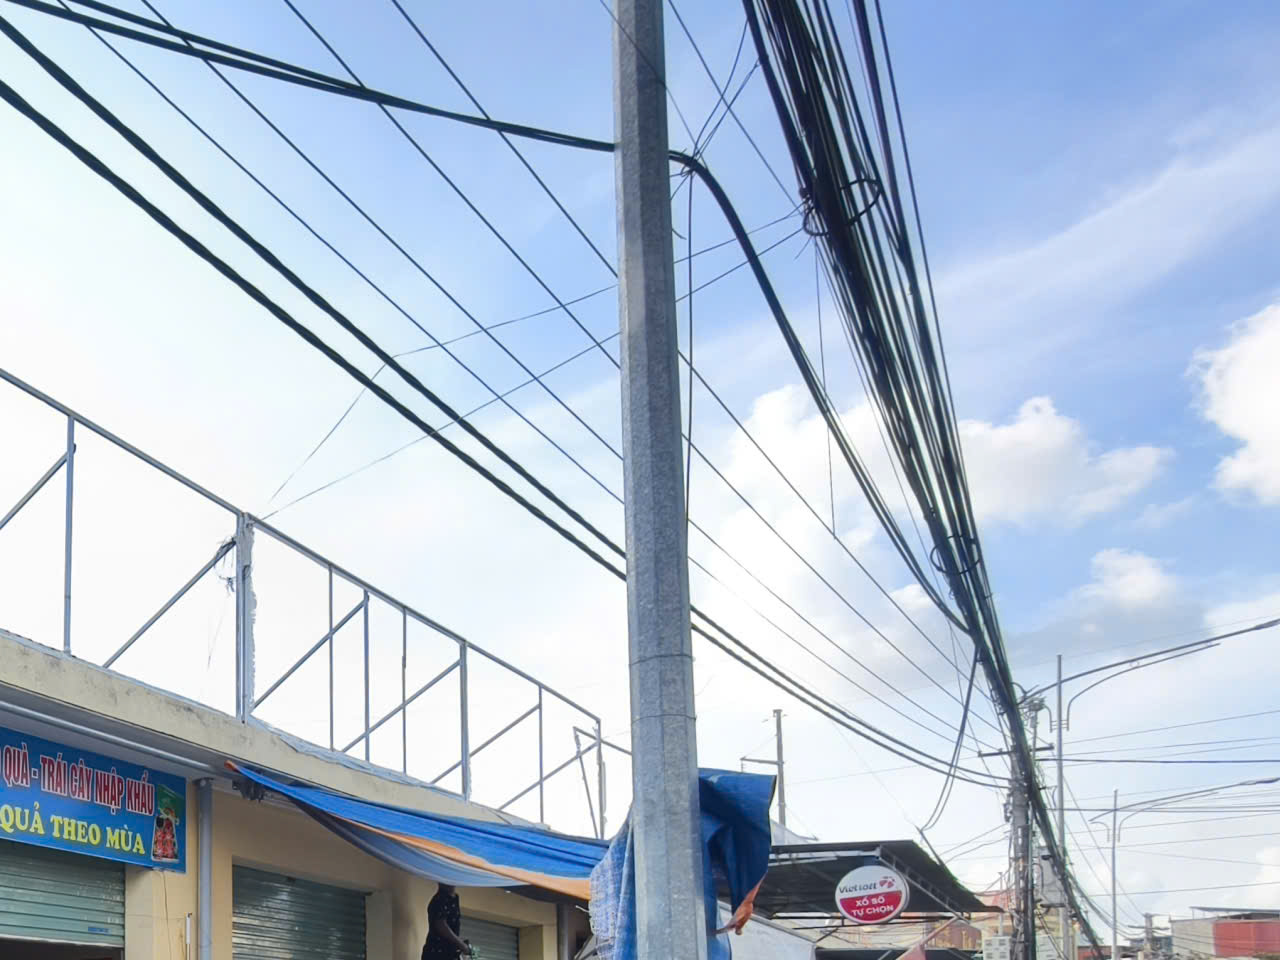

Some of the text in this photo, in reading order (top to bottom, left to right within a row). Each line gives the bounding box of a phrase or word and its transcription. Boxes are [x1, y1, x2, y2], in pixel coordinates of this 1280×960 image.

[3, 742, 31, 788] QUÀ
[40, 752, 68, 797] TRÁI
[70, 758, 93, 802] CÂY
[94, 767, 125, 815] NHẬP
[126, 770, 155, 816] KHẨU
[0, 801, 45, 834] QUẢ
[50, 815, 101, 845] THEO
[105, 824, 145, 854] MÙA
